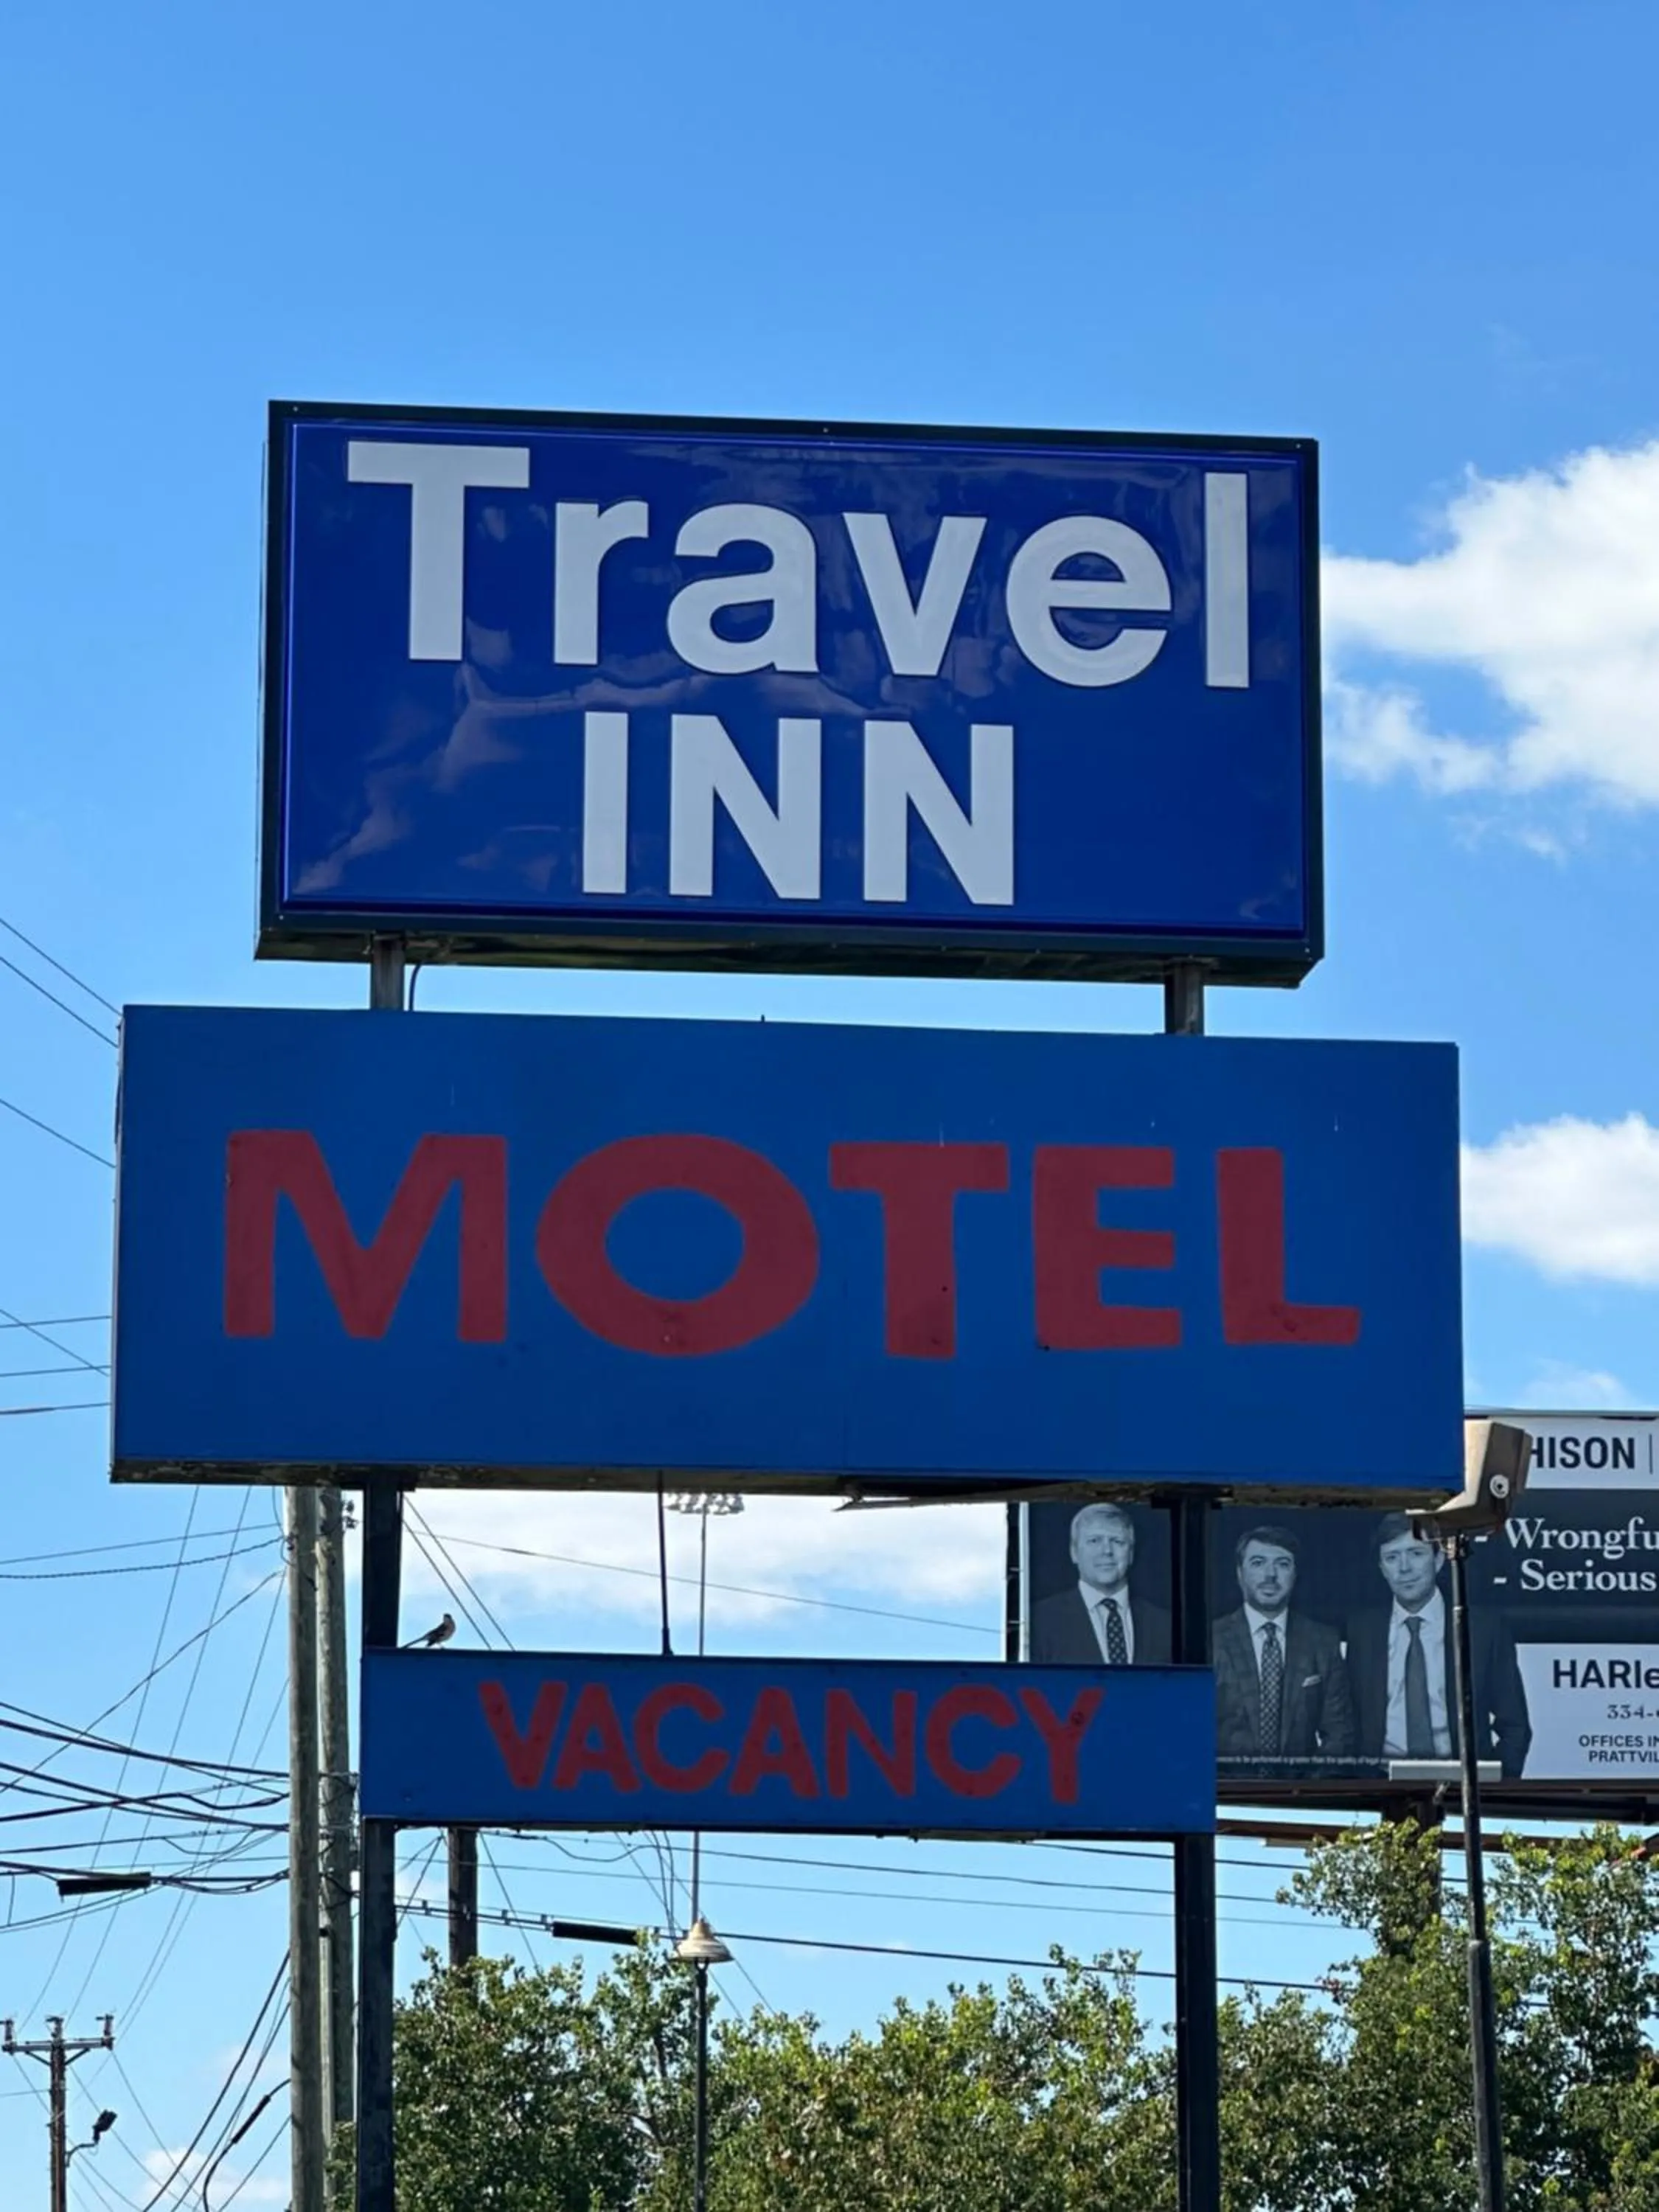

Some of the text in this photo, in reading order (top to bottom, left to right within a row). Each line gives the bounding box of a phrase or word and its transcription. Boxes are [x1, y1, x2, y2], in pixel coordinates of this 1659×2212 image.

[347, 442, 1249, 688] Travel
[582, 711, 1014, 905] INN
[225, 1129, 1360, 1357] MOTEL
[1520, 1558, 1658, 1591] Serious
[479, 1681, 1104, 1804] VACANCY
[1579, 1734, 1644, 1747] OFFICES
